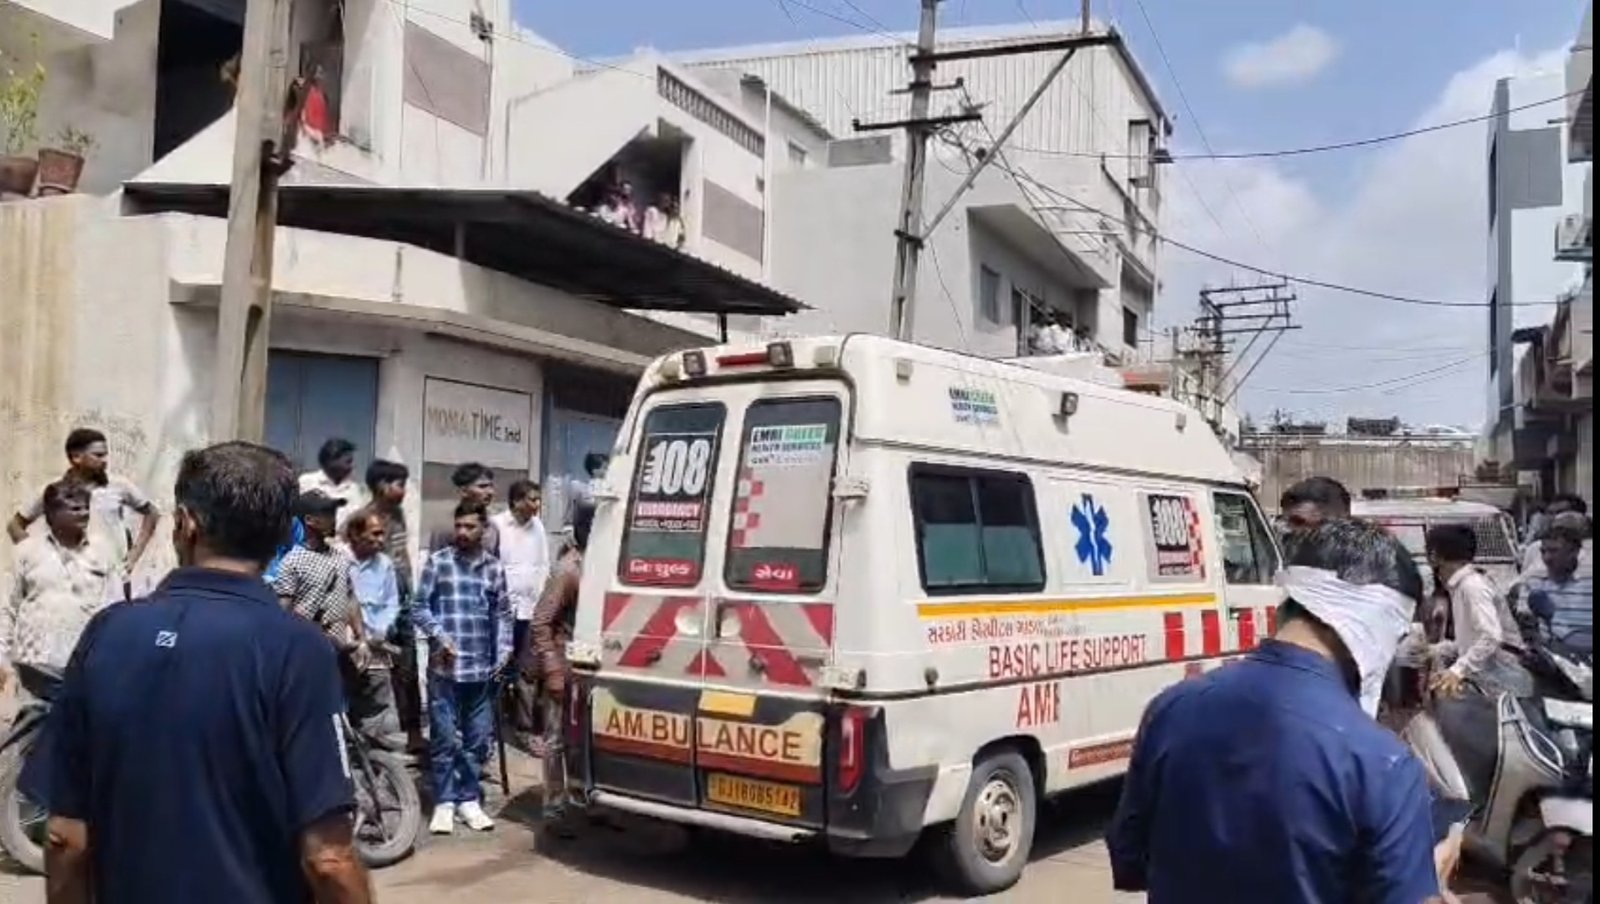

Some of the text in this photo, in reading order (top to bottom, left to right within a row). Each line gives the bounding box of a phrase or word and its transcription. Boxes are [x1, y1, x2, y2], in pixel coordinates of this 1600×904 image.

[471, 408, 502, 441] TIME
[648, 438, 710, 494] 108
[988, 634, 1147, 678] BASIC LIFE SUPPORT
